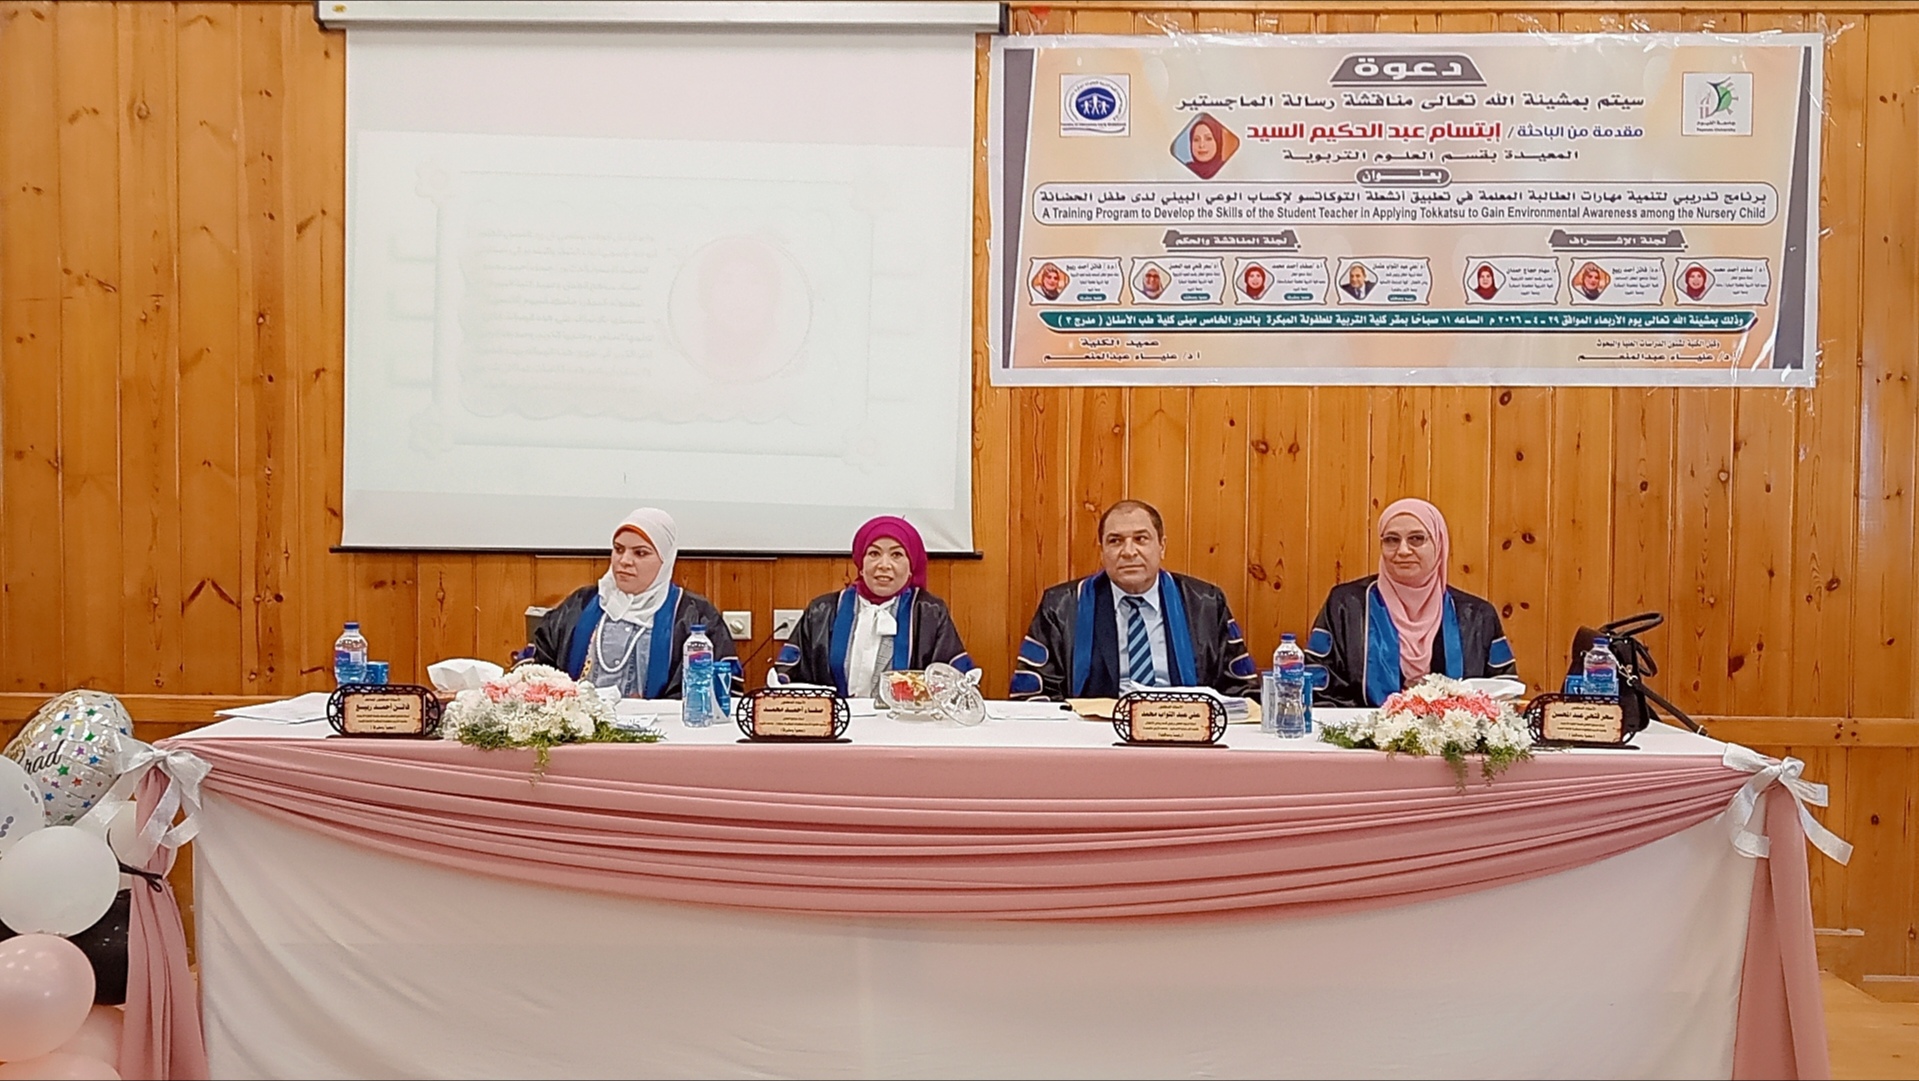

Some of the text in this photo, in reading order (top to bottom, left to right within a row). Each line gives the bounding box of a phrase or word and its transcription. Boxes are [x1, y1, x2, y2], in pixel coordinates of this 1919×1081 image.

[1354, 57, 1462, 81] دعوة
[1175, 94, 1274, 110] الماجستير
[1281, 93, 1336, 109] رسالة
[1343, 92, 1414, 108] مناقشة
[1421, 93, 1477, 110] تعالى
[1485, 92, 1515, 107] الله
[1597, 94, 1645, 110] سيتم
[1246, 122, 1305, 142] السيد
[1309, 122, 1383, 143] الحكيم
[1388, 125, 1425, 143] عبد
[1516, 122, 1565, 141] الباحثة
[1567, 125, 1589, 140] من
[1592, 125, 1644, 138] مقدمة
[1282, 148, 1579, 164] المعيدة بقسم العلوم التربوية
[1361, 168, 1443, 184] بعنوان
[1039, 190, 1093, 202] الحضانة
[1097, 190, 1126, 204] طفل
[1205, 191, 1243, 205] الوعي
[1298, 191, 1361, 204] التوكاتسو
[1410, 191, 1451, 204] تطبيق
[1456, 190, 1473, 205] في
[1478, 190, 1523, 202] المعلمة
[1527, 189, 1576, 204] الطالبة
[1580, 190, 1623, 204] مهارات
[1626, 190, 1668, 204] لتنمية
[1672, 190, 1719, 206] تدريبي
[1723, 191, 1767, 204] برنامج
[1042, 206, 1766, 221] A Training Program to Develop the Skills of the Student Teacher in Applying Tokkatsu to Gain Environmental Awareness among the Nursery Child
[1138, 314, 1155, 326] طب
[1157, 314, 1175, 326] كلية
[1199, 314, 1231, 327] الخامس
[1232, 314, 1262, 327] بالدور
[1266, 314, 1298, 327] المبكرة
[1335, 314, 1367, 327] التربية
[1368, 313, 1388, 326] كلية
[1561, 315, 1592, 327] الموافق
[1628, 316, 1643, 327] يوم
[1644, 314, 1671, 326] تعالى
[1672, 313, 1687, 325] الله
[1720, 314, 1744, 326] وذلك
